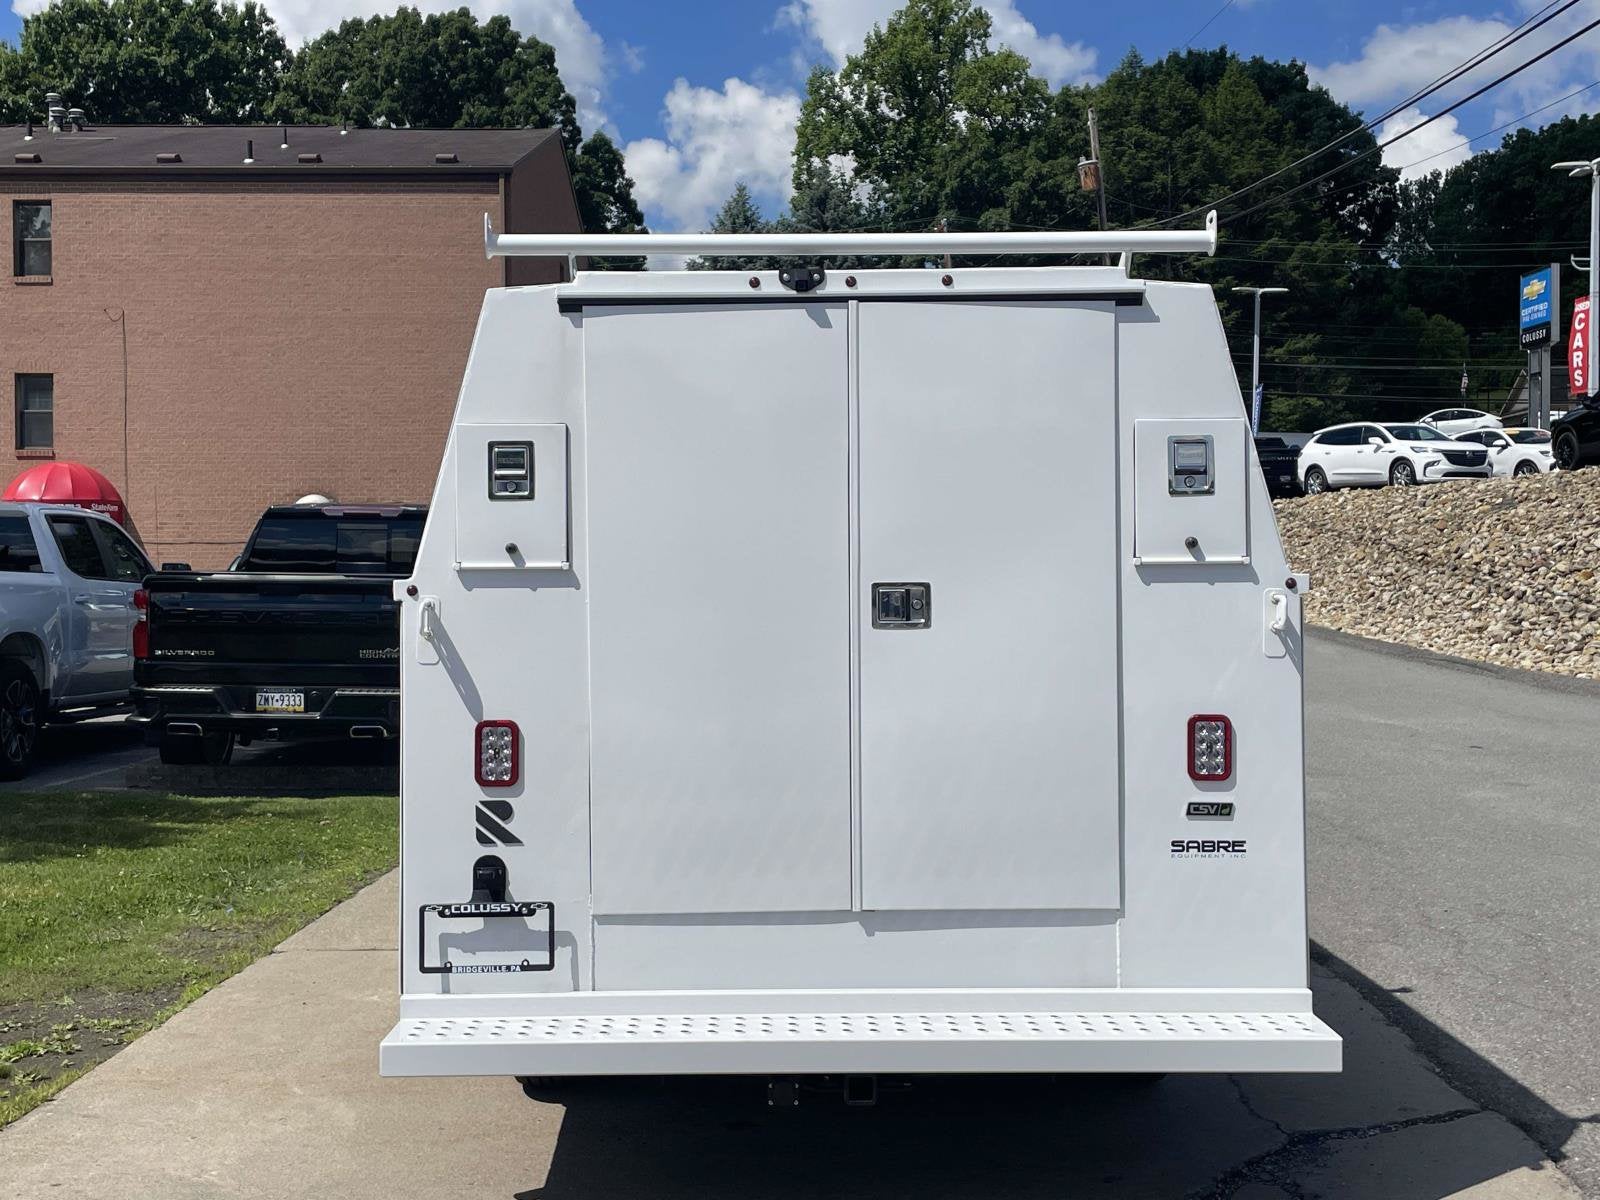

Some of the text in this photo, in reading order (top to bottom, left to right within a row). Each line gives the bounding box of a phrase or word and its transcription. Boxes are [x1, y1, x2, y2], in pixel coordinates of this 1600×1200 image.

[1521, 302, 1547, 316] CERTIFIED
[1522, 329, 1546, 343] COLUSSY
[1573, 313, 1585, 387] CARS
[1189, 804, 1218, 815] CSV
[1171, 840, 1246, 853] SABRE
[451, 903, 522, 914] COLUSSY
[510, 965, 522, 973] PA
